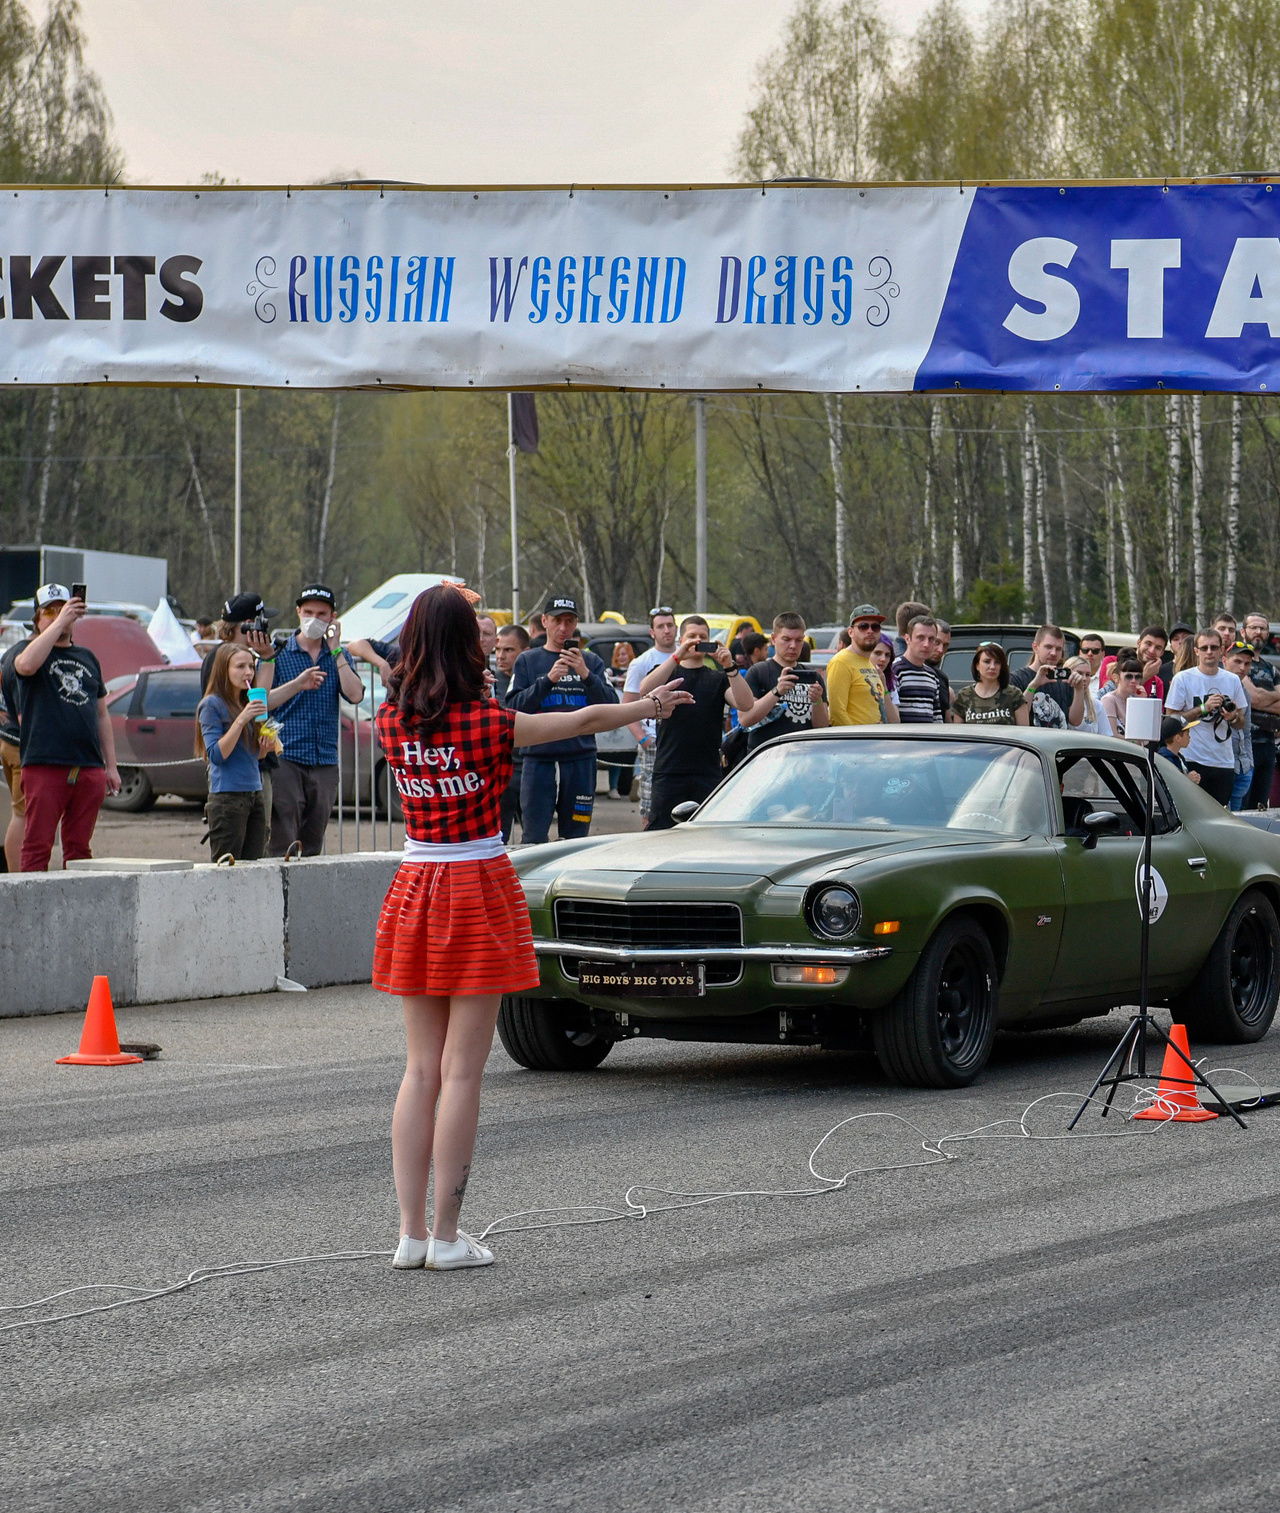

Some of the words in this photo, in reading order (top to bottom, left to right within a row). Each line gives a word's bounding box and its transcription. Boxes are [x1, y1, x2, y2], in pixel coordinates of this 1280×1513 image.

[0, 255, 204, 323] KETS
[288, 255, 456, 323] RUSSIAN
[488, 256, 687, 324] WEEKEND
[714, 255, 854, 326] DRAGS
[553, 598, 575, 609] POLICE
[401, 741, 461, 771] Hey,
[437, 771, 485, 798] me.
[582, 974, 600, 984] BIG
[603, 975, 631, 985] BOYS'
[634, 976, 657, 985] BIG
[661, 976, 695, 985] TOYS
